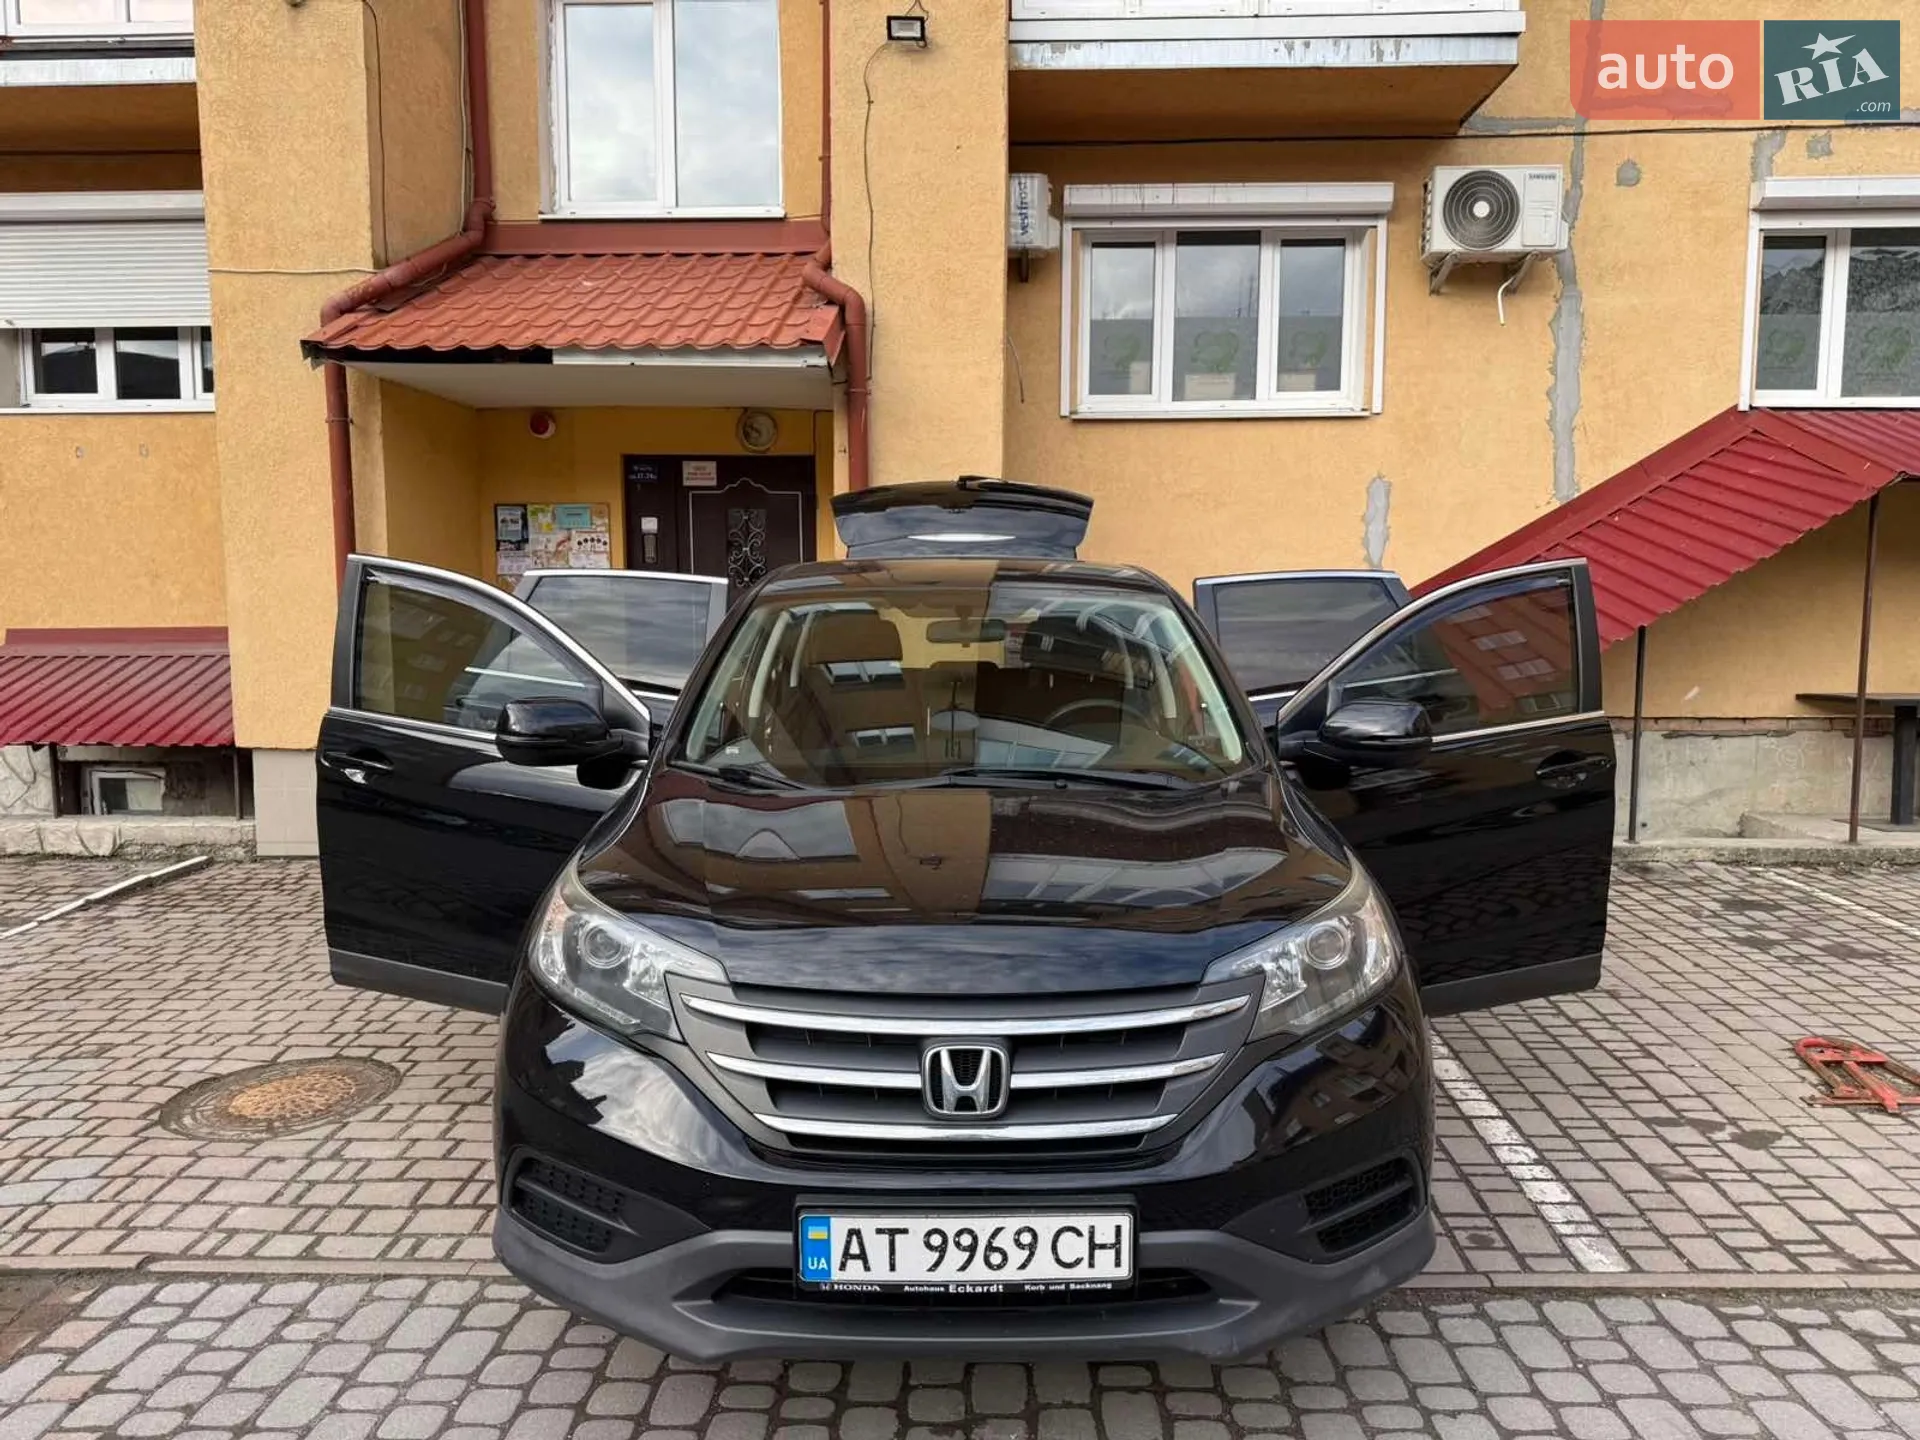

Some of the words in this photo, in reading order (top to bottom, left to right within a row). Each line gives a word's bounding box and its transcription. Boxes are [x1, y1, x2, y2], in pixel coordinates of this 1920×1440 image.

[838, 1227, 909, 1272] AT
[922, 1225, 1039, 1272] 9969
[1050, 1224, 1122, 1270] CH
[808, 1257, 829, 1270] UA
[833, 1283, 881, 1292] HONDA
[903, 1284, 945, 1293] Autohaus
[948, 1283, 1004, 1294] Eckardt
[1024, 1283, 1046, 1292] Korb
[1048, 1283, 1066, 1291] und
[1069, 1281, 1113, 1290] Backnang
